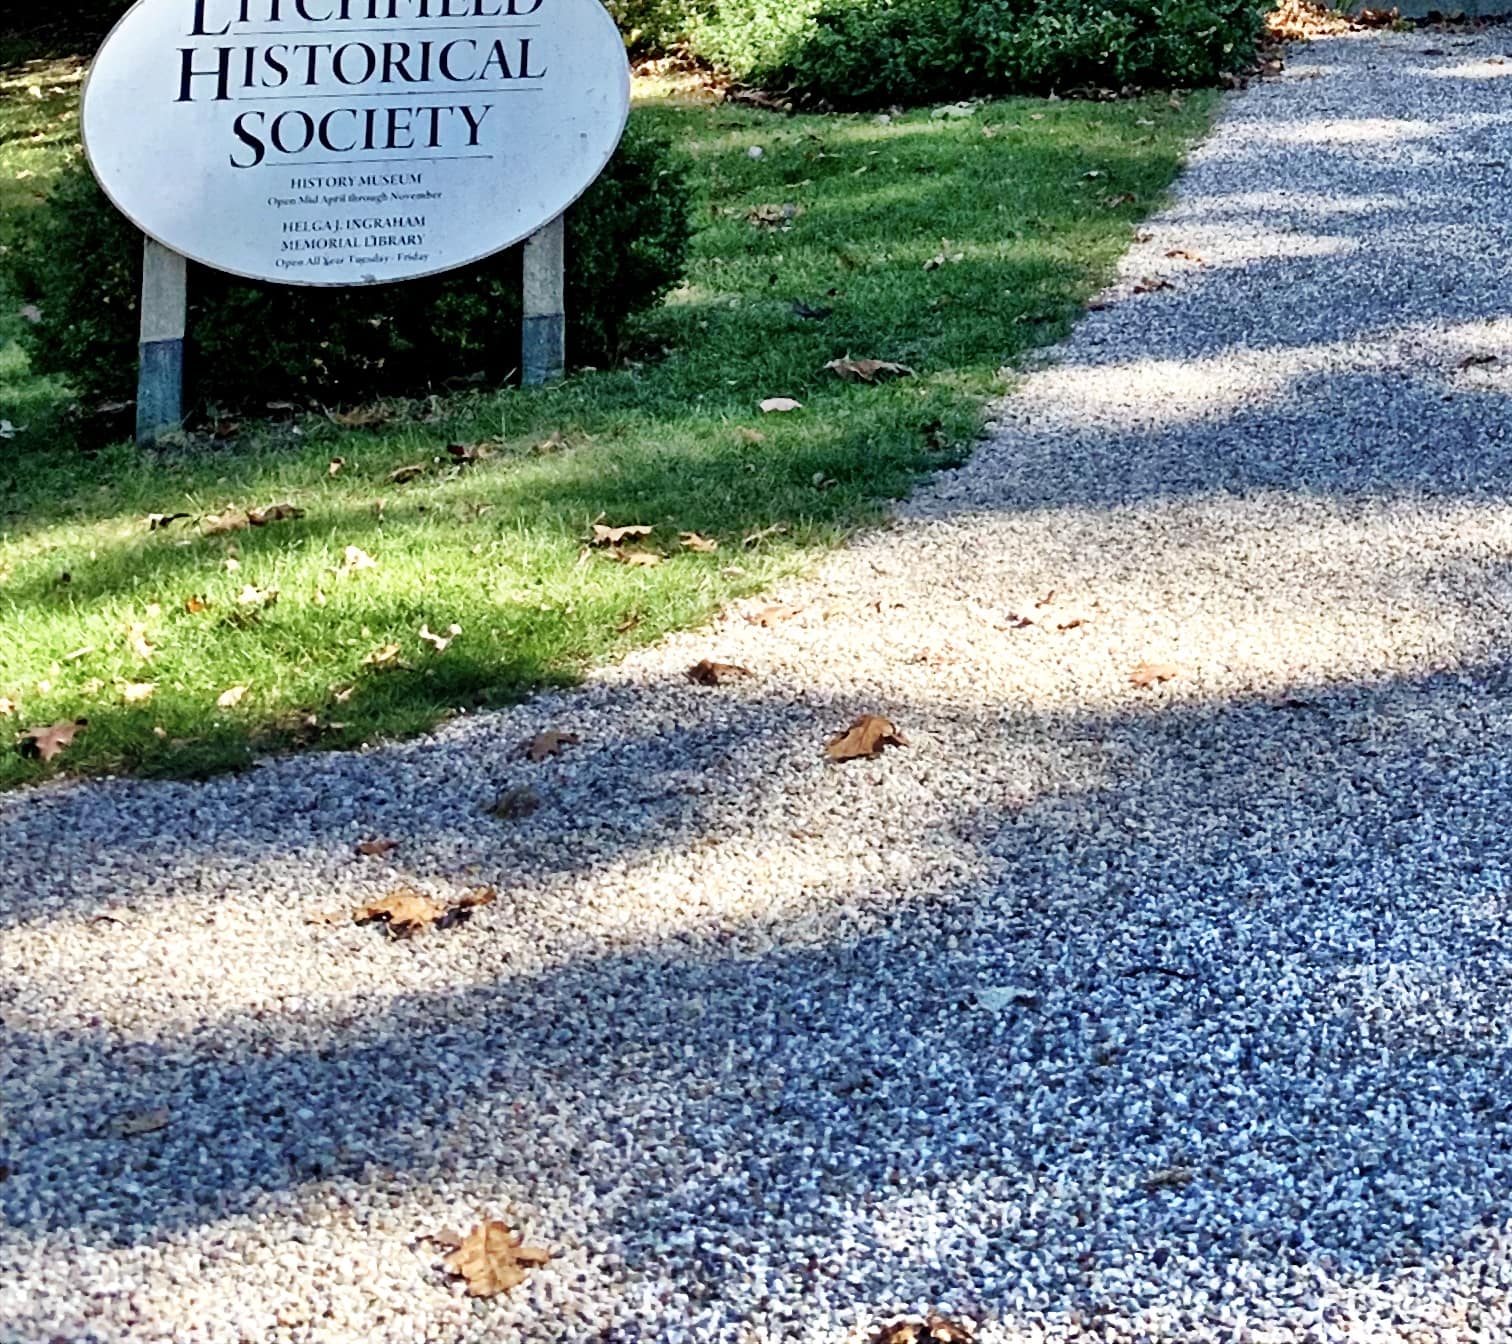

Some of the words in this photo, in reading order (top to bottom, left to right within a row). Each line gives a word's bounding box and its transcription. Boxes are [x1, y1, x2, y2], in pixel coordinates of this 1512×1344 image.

[173, 38, 548, 103] HISTORICAL
[229, 104, 494, 169] SOCIETY
[290, 175, 355, 190] HISTORY
[357, 172, 423, 187] MUSEUM
[267, 196, 297, 209] Open
[299, 194, 319, 205] Mid
[322, 192, 347, 207] April
[348, 191, 389, 205] through
[390, 189, 443, 201] November
[282, 218, 333, 234] HELGA
[345, 215, 426, 231] INGRAHAM
[280, 236, 361, 252] MEMORIAL
[364, 233, 426, 248] LIBRARY
[275, 256, 306, 269] Open
[307, 255, 321, 266] All
[349, 253, 390, 266] Tuesday
[397, 251, 430, 264] Friday
